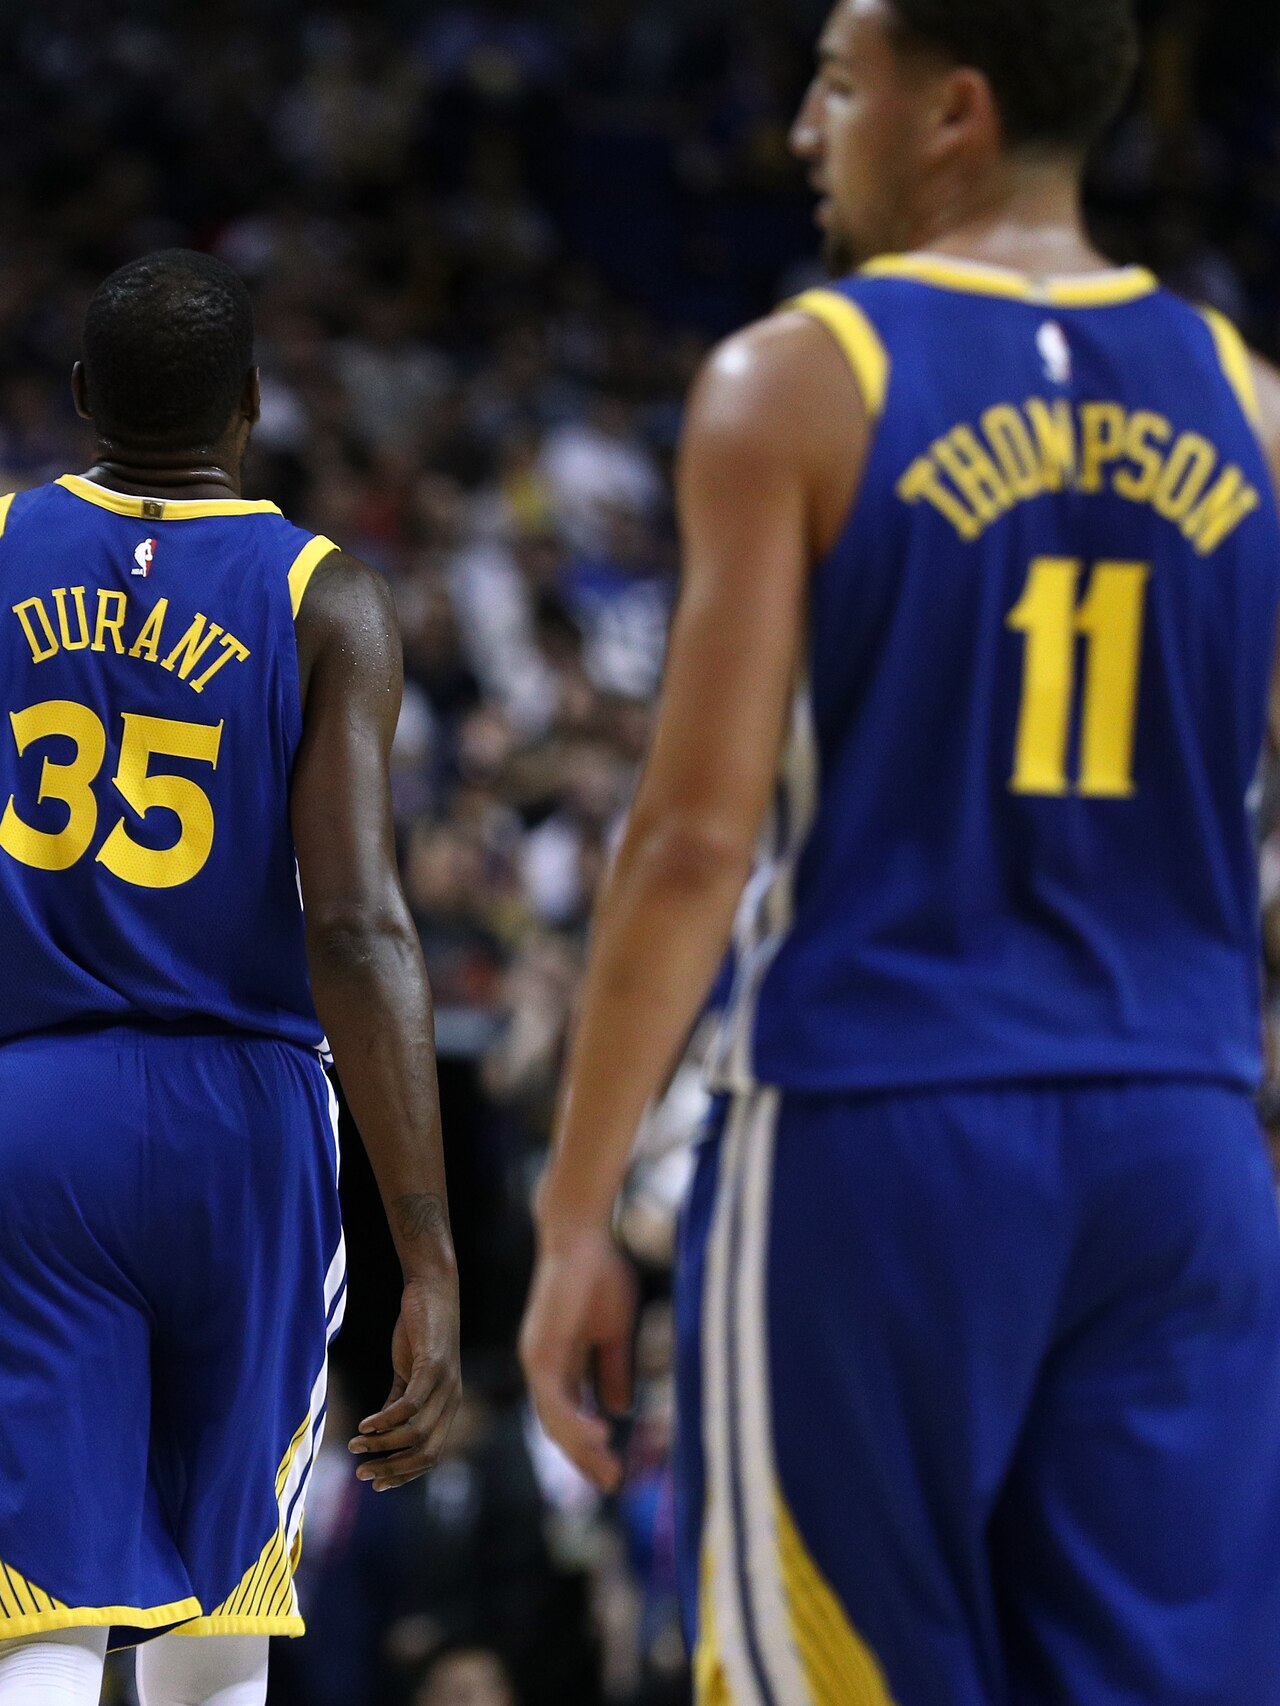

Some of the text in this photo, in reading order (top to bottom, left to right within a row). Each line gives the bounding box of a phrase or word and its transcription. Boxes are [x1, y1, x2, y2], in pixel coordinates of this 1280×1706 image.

[897, 398, 1261, 557] THOMPSON
[12, 585, 251, 694] DURANT
[1006, 555, 1151, 799] 11
